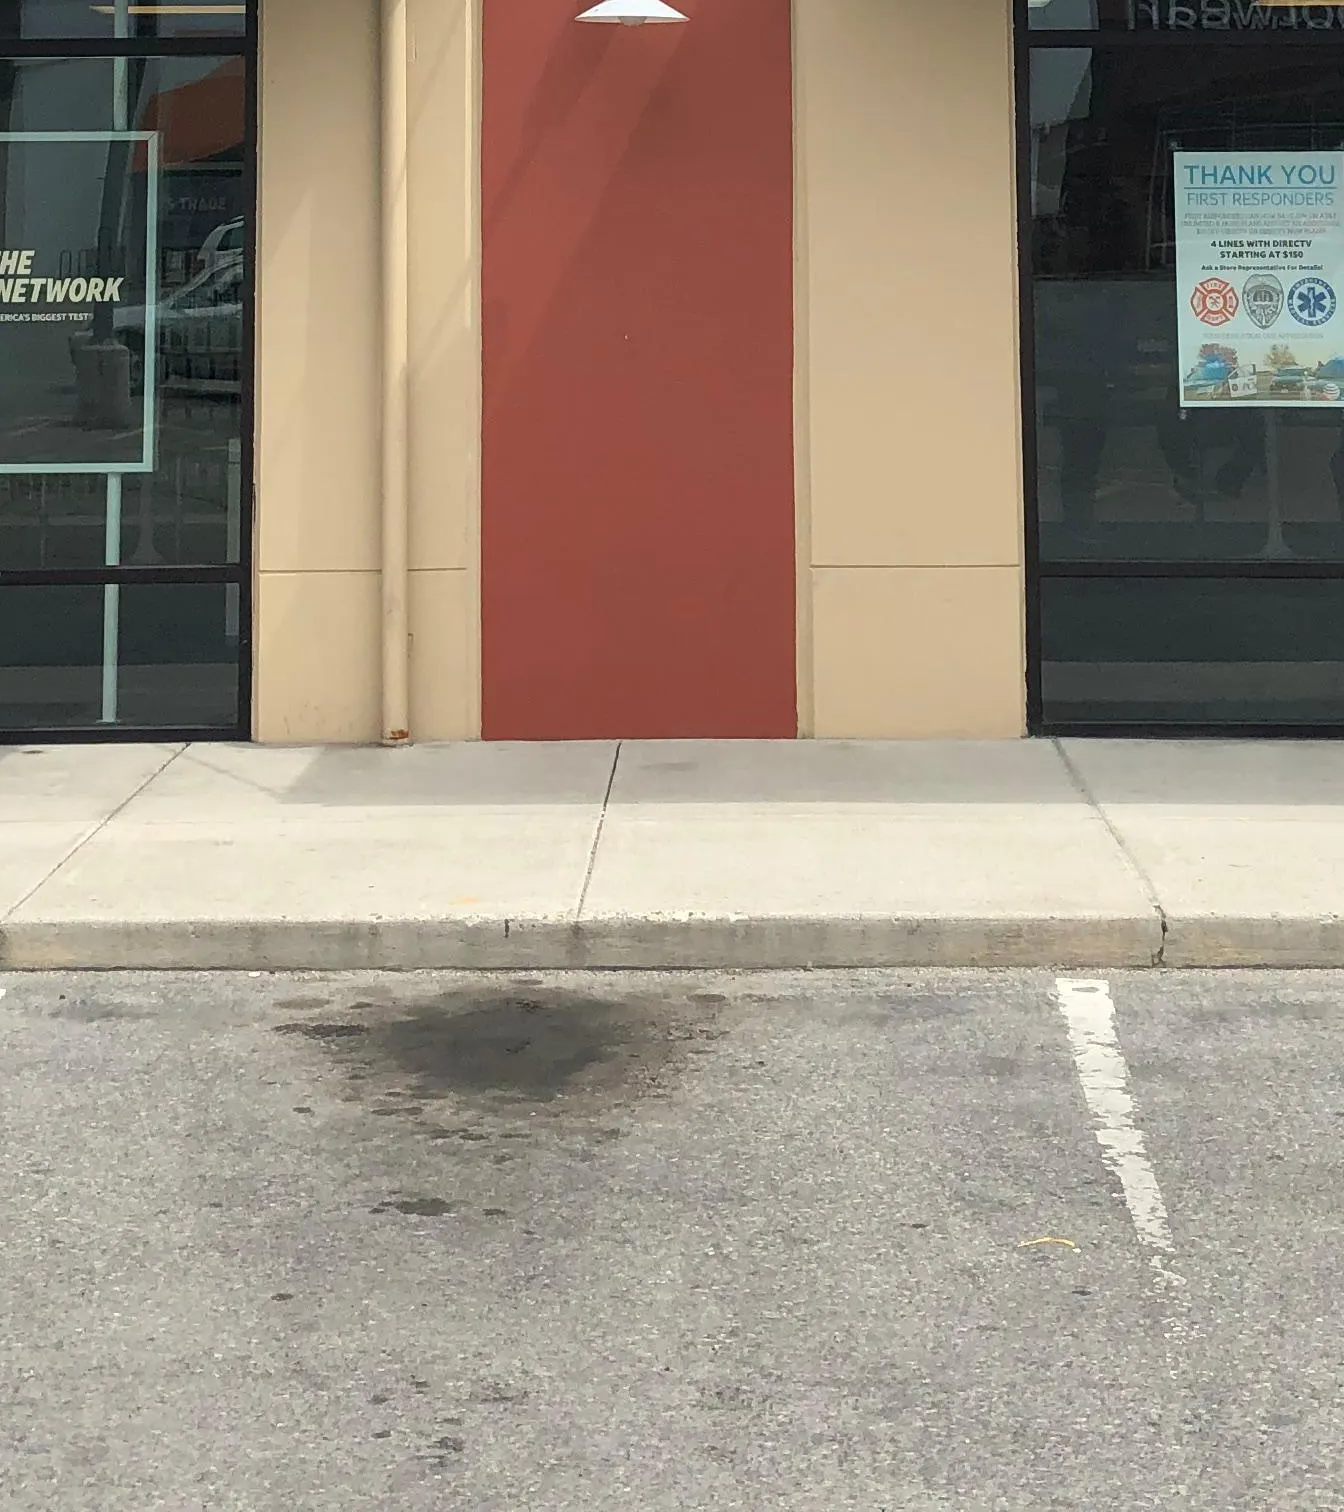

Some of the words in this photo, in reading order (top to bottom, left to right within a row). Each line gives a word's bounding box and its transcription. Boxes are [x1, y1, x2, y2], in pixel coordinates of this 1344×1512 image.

[1184, 165, 1273, 184] THANK
[1281, 165, 1335, 184] YOU
[1187, 192, 1228, 205] FIRST
[1233, 192, 1334, 206] RESPONDERS
[32, 313, 66, 321] BIGGEST
